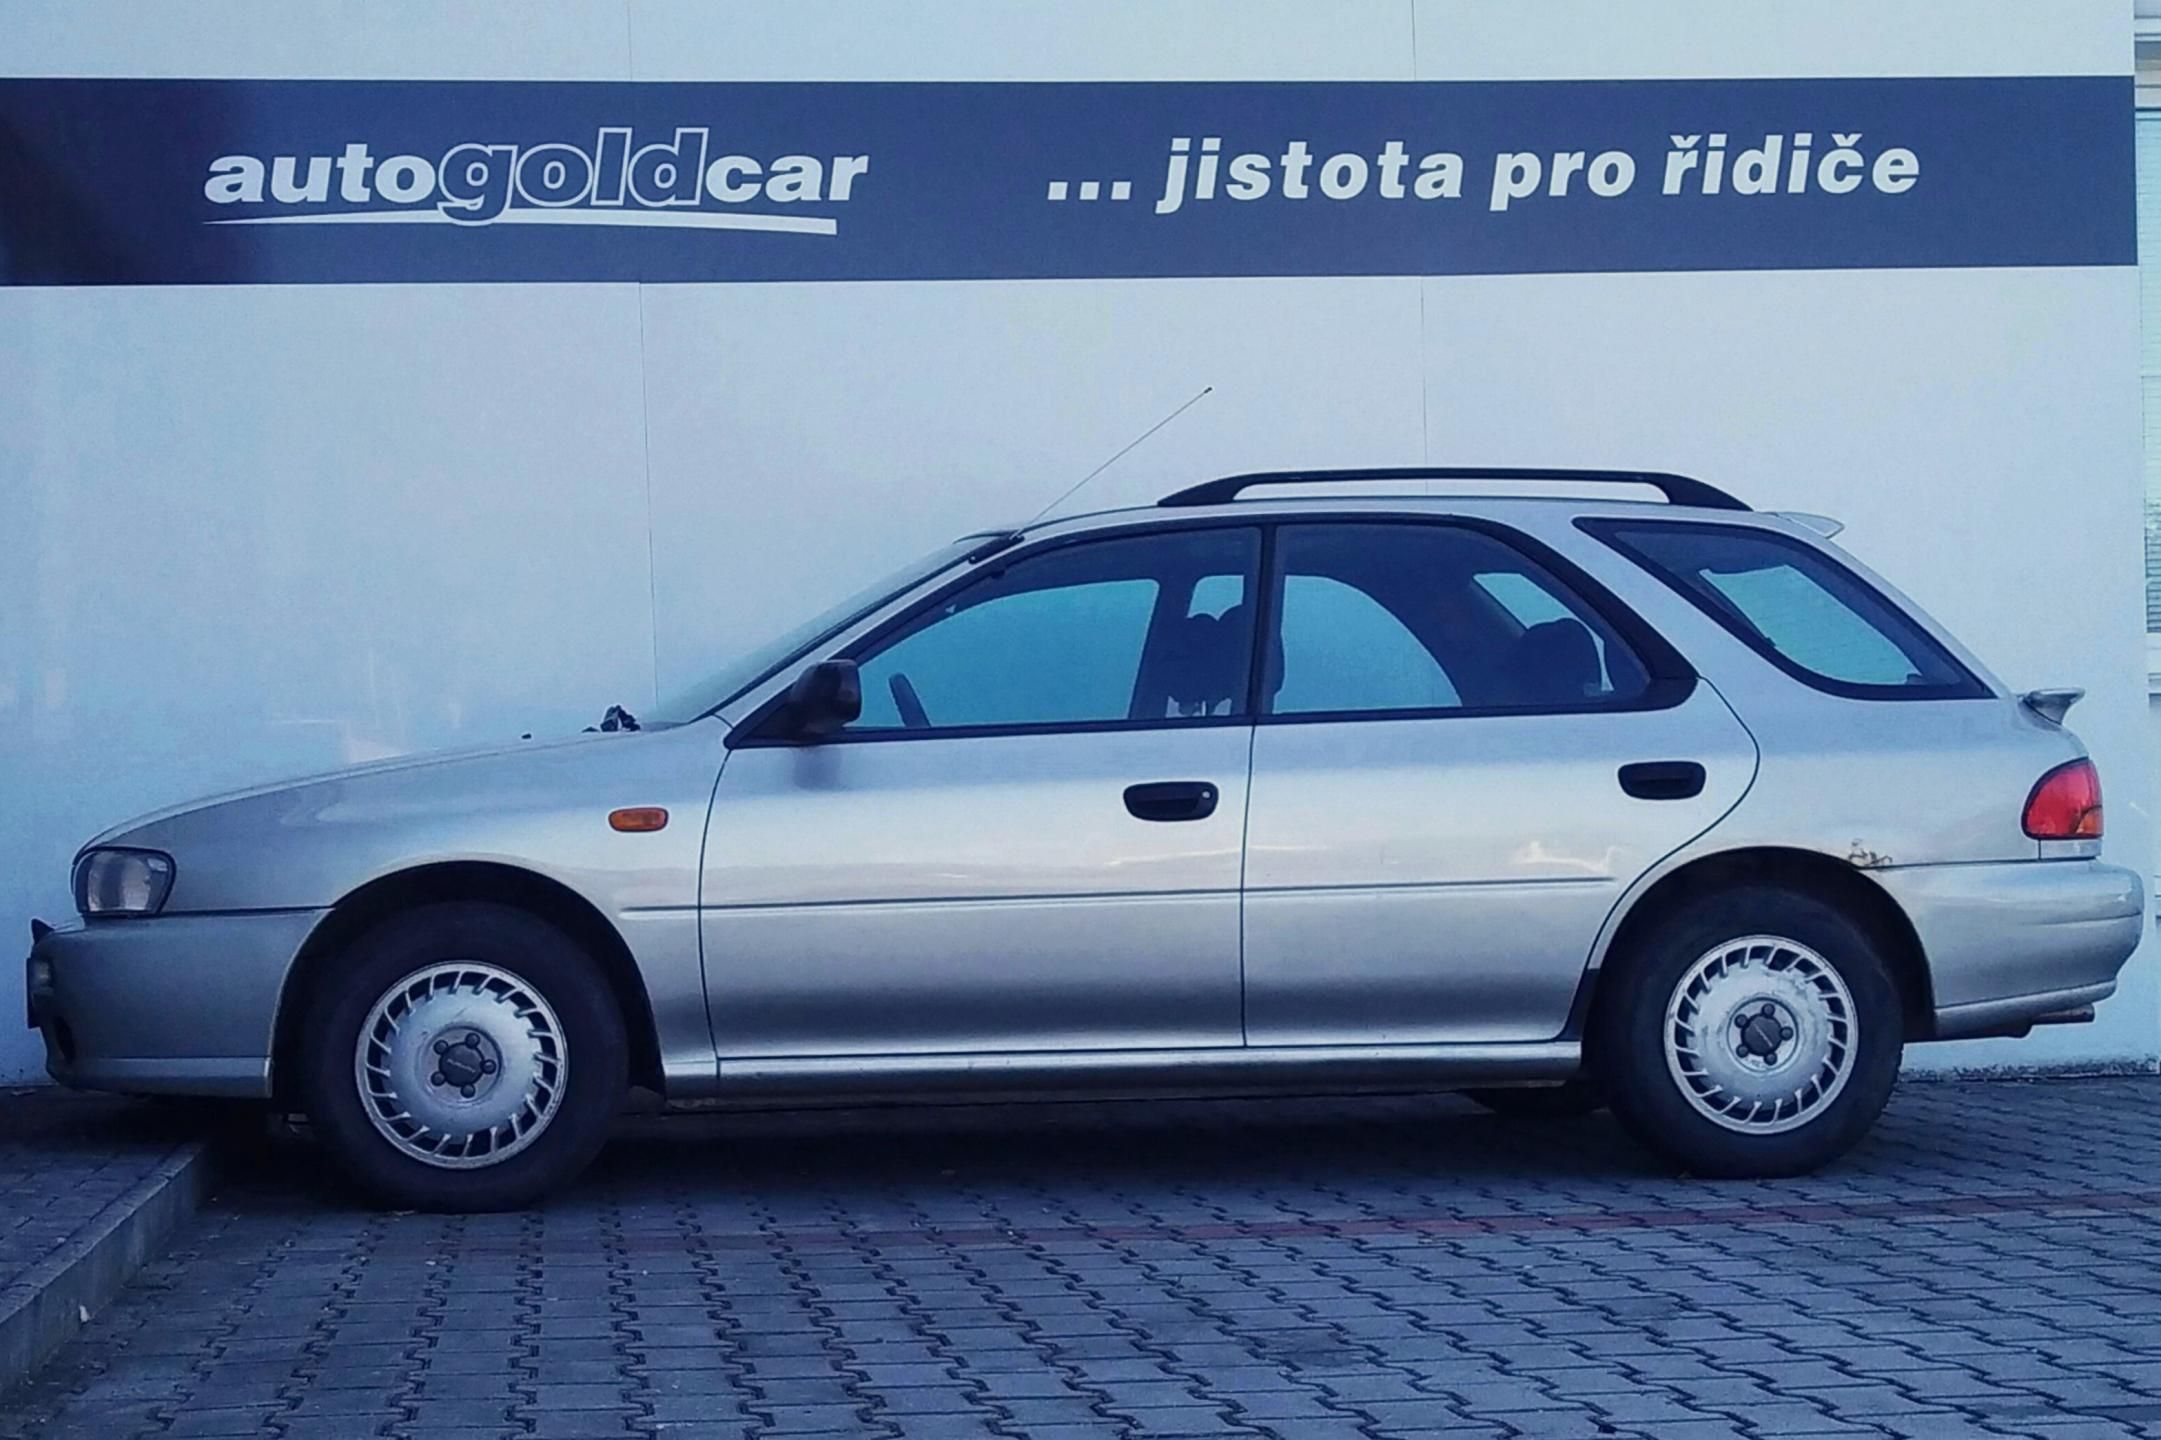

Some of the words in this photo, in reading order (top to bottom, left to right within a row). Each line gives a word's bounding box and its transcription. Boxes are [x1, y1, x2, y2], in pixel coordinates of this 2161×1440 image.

[204, 126, 869, 227] autogoldcar
[1155, 137, 1464, 214] jistota
[1489, 150, 1636, 212] pro
[1662, 132, 1920, 195] řidiče
